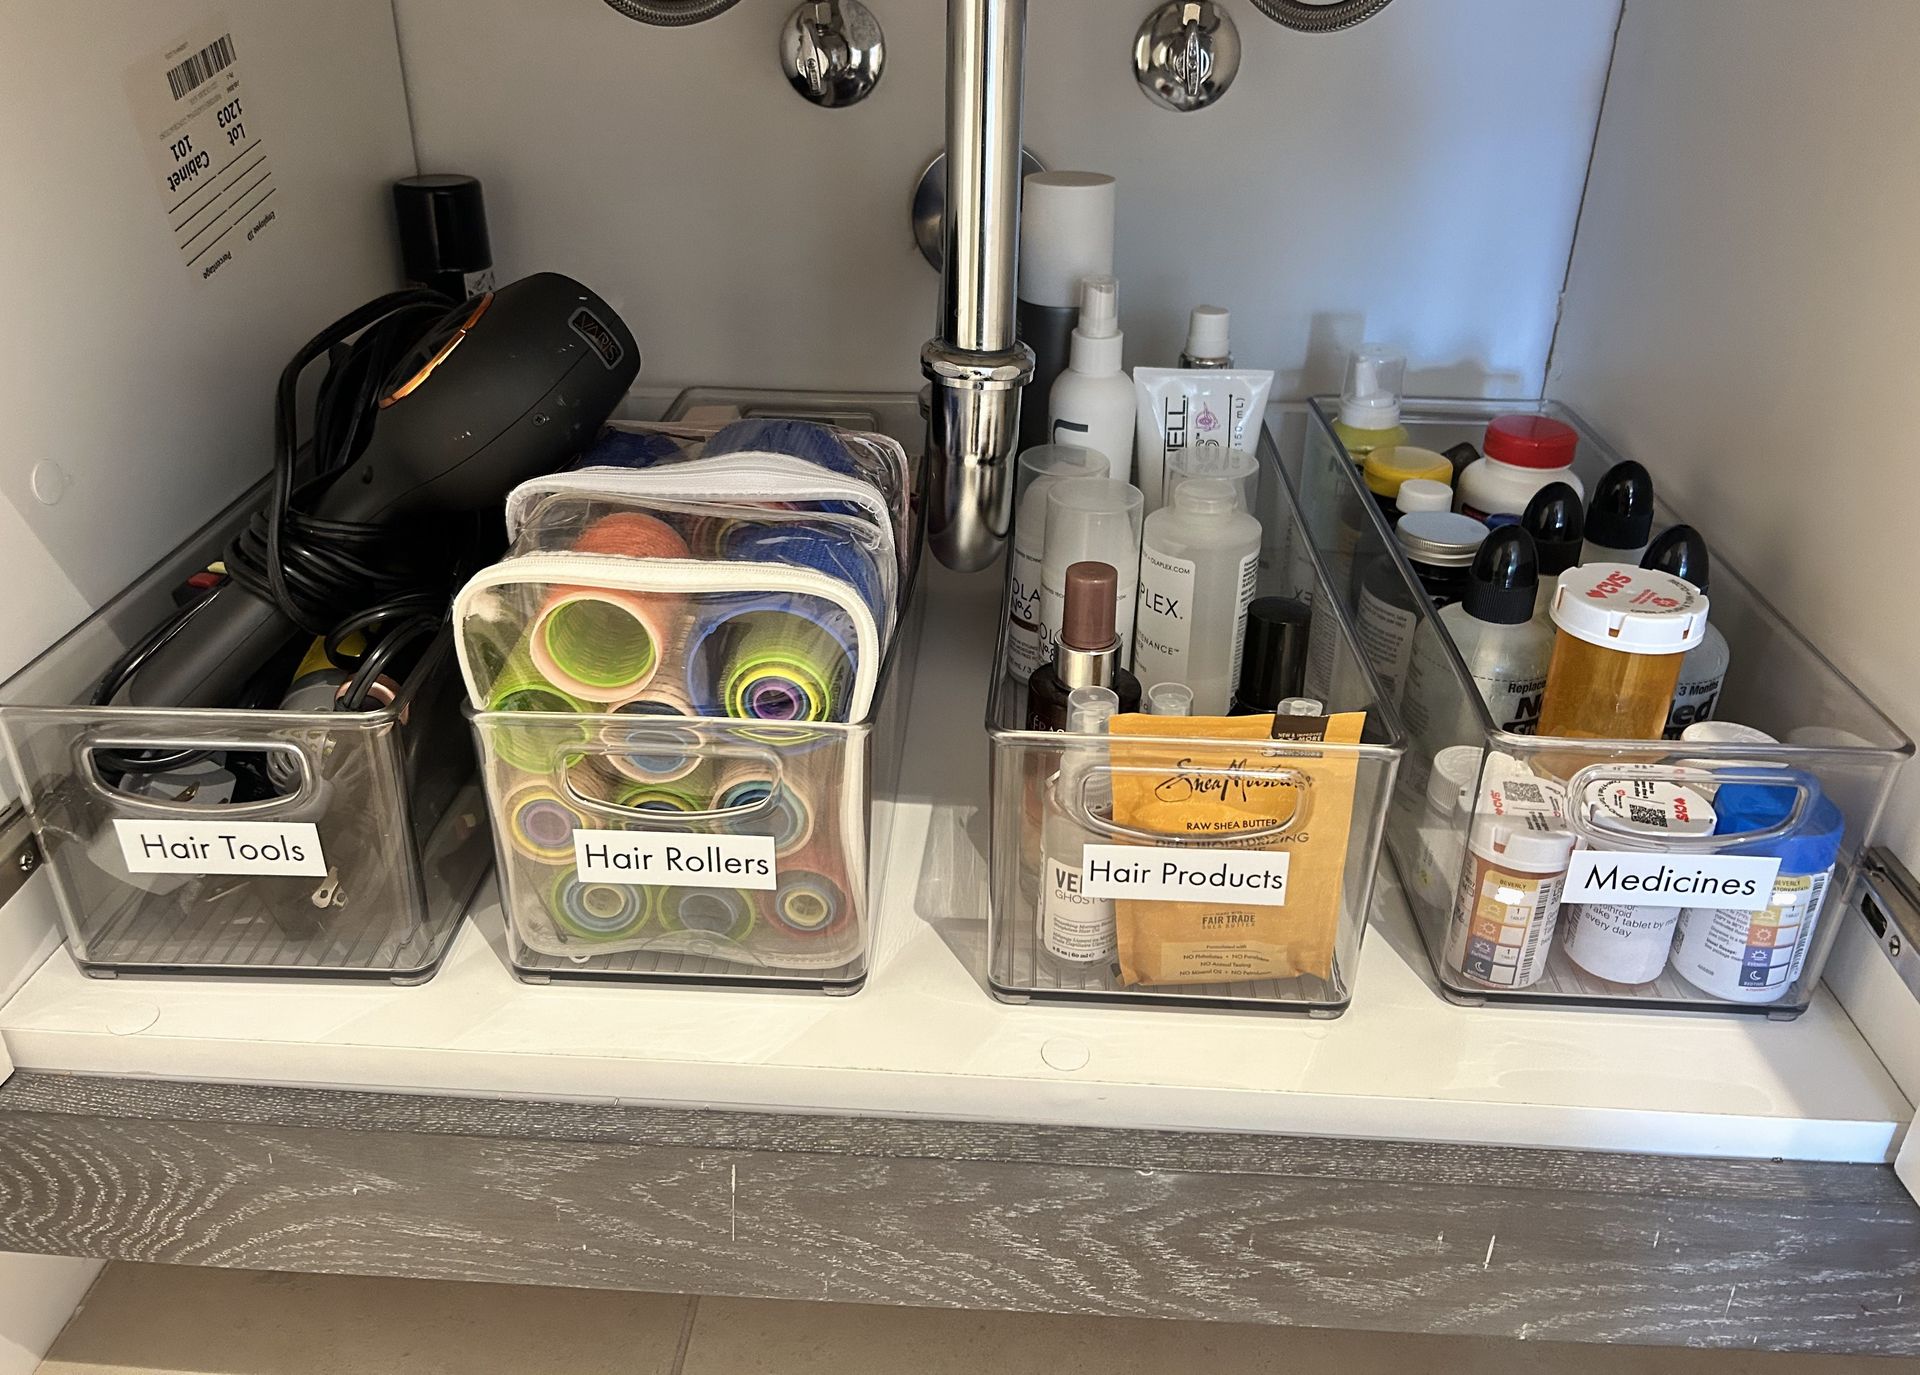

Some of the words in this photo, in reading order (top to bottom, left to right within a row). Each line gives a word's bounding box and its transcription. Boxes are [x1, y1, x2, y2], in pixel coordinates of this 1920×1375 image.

[217, 98, 242, 128] 1203
[227, 123, 246, 146] Lot
[170, 134, 193, 162] 101
[167, 150, 210, 192] Cabinet
[253, 211, 276, 234] Employee
[203, 251, 232, 279] Percentage
[1011, 577, 1041, 602] OLA
[1596, 570, 1632, 595] CVS
[1678, 686, 1687, 697] 3
[1689, 680, 1719, 696] Months
[1186, 821, 1212, 831] RAW
[1213, 820, 1240, 831] SHEA
[1242, 818, 1278, 829] BUTTER
[140, 833, 210, 860] Hair
[217, 834, 306, 862] Tools
[585, 843, 653, 870] Hair
[665, 846, 769, 876] Rollers
[1056, 867, 1083, 894] VE
[1090, 859, 1151, 884] Hair
[1161, 862, 1283, 890] Products
[1500, 879, 1527, 889] BEVERLY
[1583, 864, 1757, 896] Medicines
[1202, 915, 1224, 926] FAIR
[1226, 914, 1256, 925] TRADE
[1585, 912, 1610, 932] every
[1612, 925, 1632, 938] day
[1622, 918, 1651, 930] tablet
[1653, 921, 1665, 932] by
